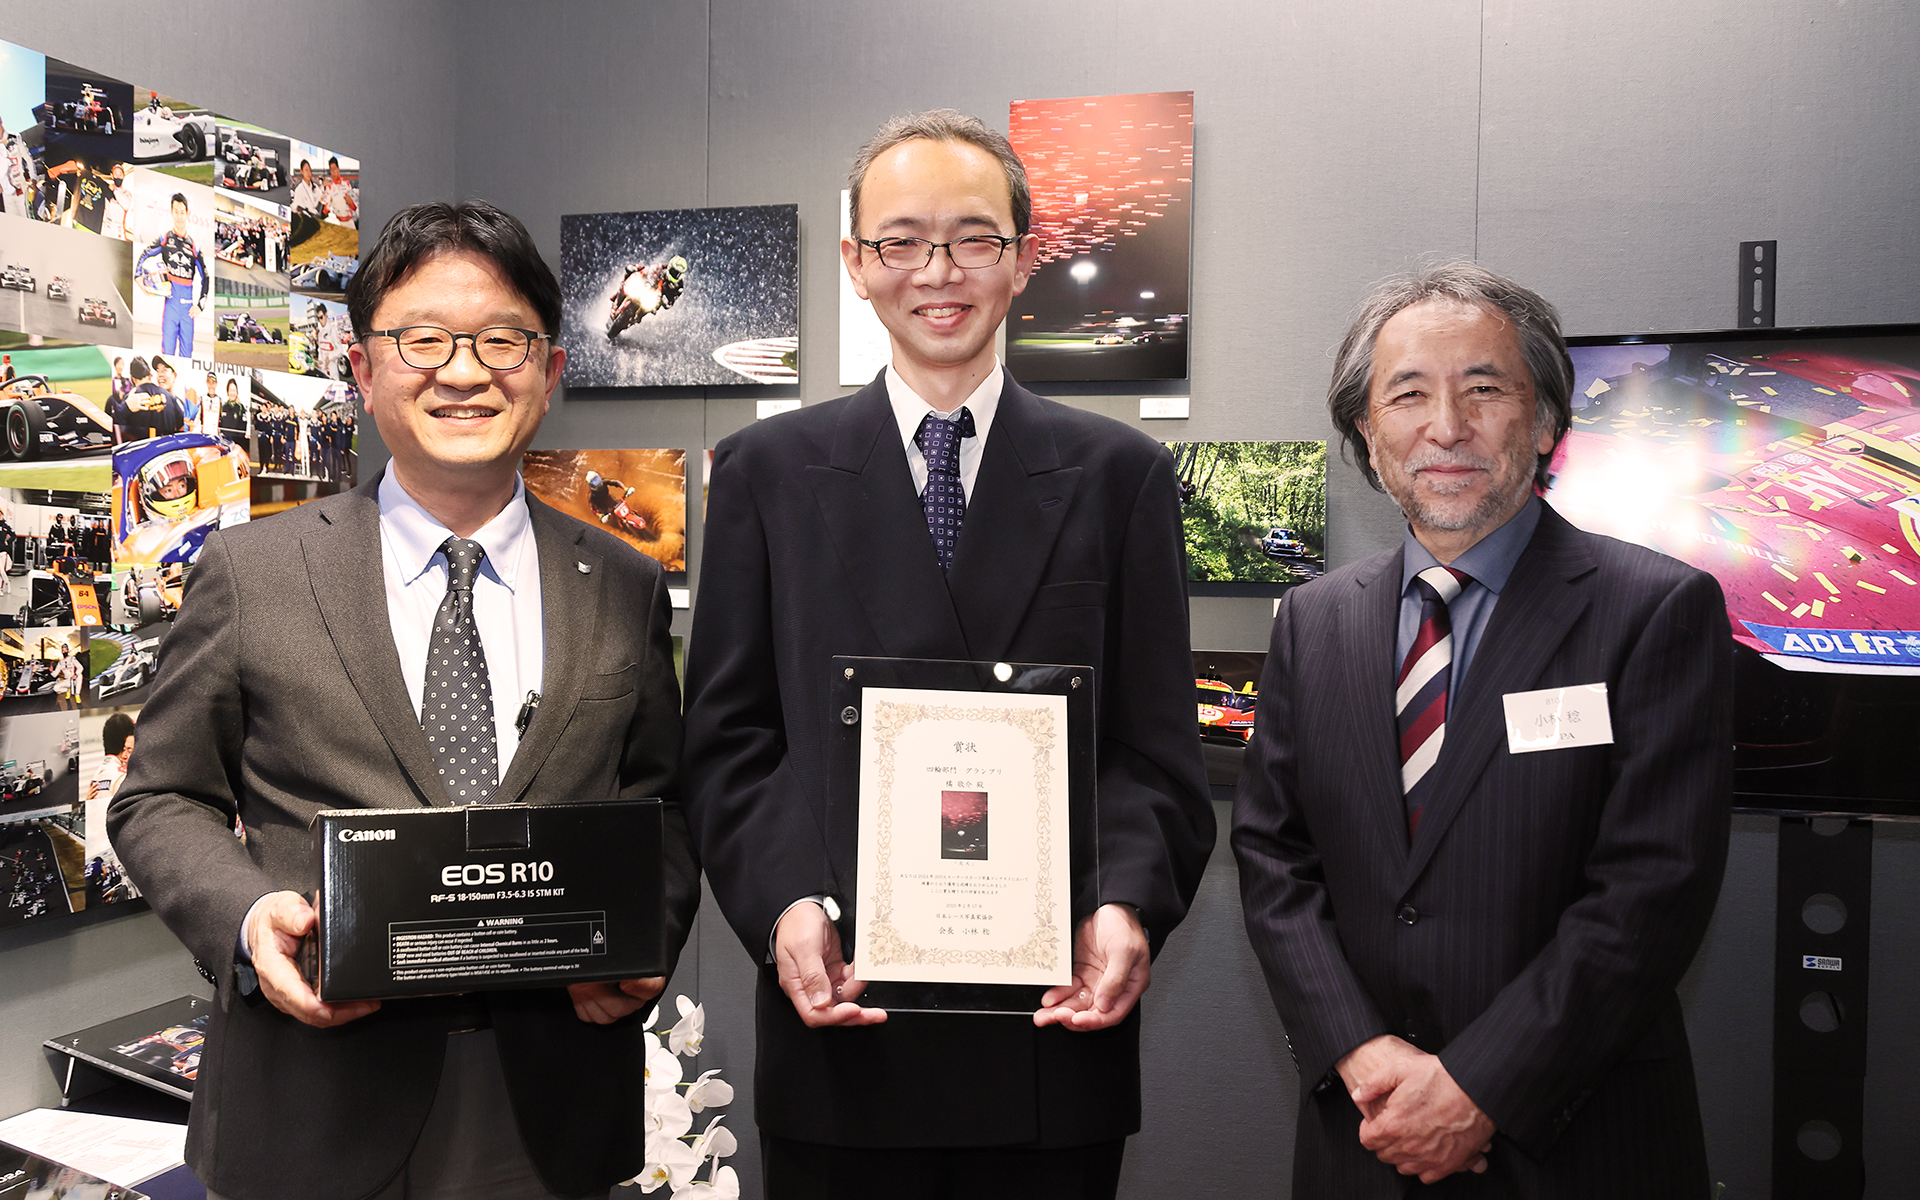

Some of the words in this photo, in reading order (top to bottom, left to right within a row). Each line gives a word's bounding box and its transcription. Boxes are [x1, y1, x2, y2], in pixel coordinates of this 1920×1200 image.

[1725, 540, 1794, 567] MILLE
[1783, 633, 1900, 655] ADLER
[954, 741, 978, 753] 賞状
[966, 767, 1002, 775] グランプリ
[338, 829, 396, 842] Canon
[442, 864, 505, 886] EOS
[511, 861, 554, 883] R10
[430, 894, 456, 902] RF-S
[456, 892, 496, 902] 18-150mm
[496, 890, 526, 899] F3.5-6.3
[528, 890, 534, 898] IS
[536, 888, 552, 897] STM
[553, 888, 564, 896] KIT
[486, 918, 524, 926] WARNING
[1818, 958, 1840, 966] SANWA
